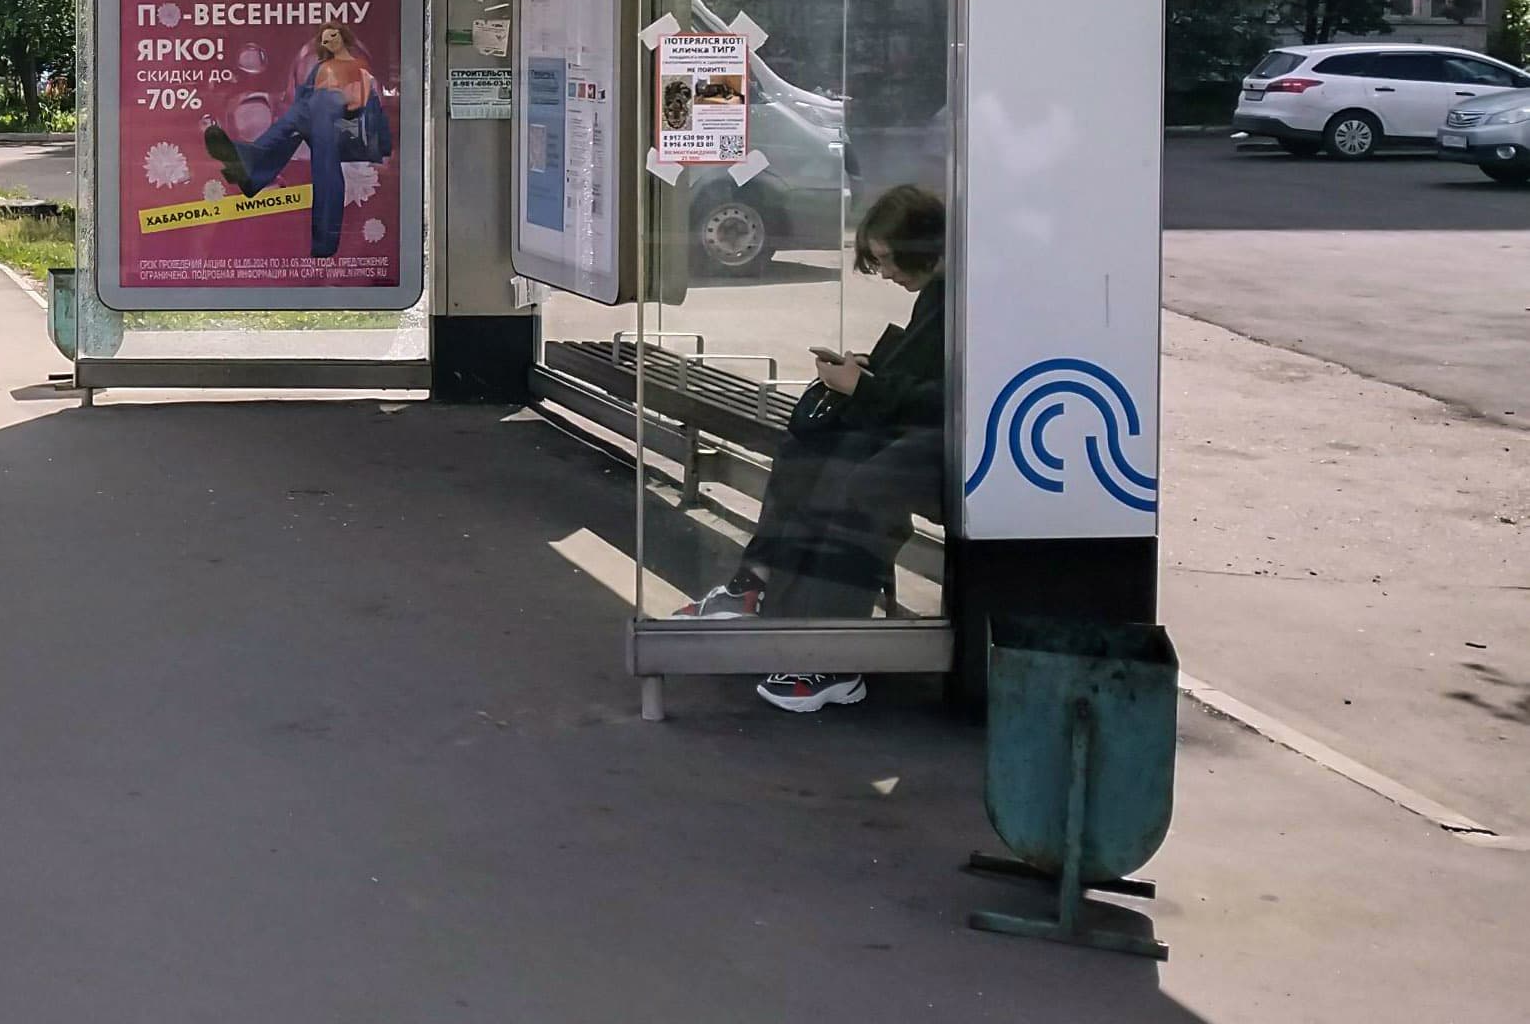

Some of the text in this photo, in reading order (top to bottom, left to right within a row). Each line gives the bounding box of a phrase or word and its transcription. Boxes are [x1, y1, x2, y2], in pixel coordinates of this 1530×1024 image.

[137, 1, 371, 27] П-ВЕСЕННЕМУ
[665, 37, 744, 45] ПОТЕРЯЛСЯ КОТ!
[137, 38, 224, 61] ЯРКО!
[137, 69, 233, 84] СКИДКИ ДО
[137, 88, 203, 110] -70%
[235, 193, 301, 212] NWMOS.RU
[214, 206, 221, 216] 2
[140, 259, 157, 270] СРОК
[227, 258, 232, 268] С
[269, 258, 280, 268] ПО
[289, 268, 299, 278] НА
[300, 268, 324, 278] САЙТЕ
